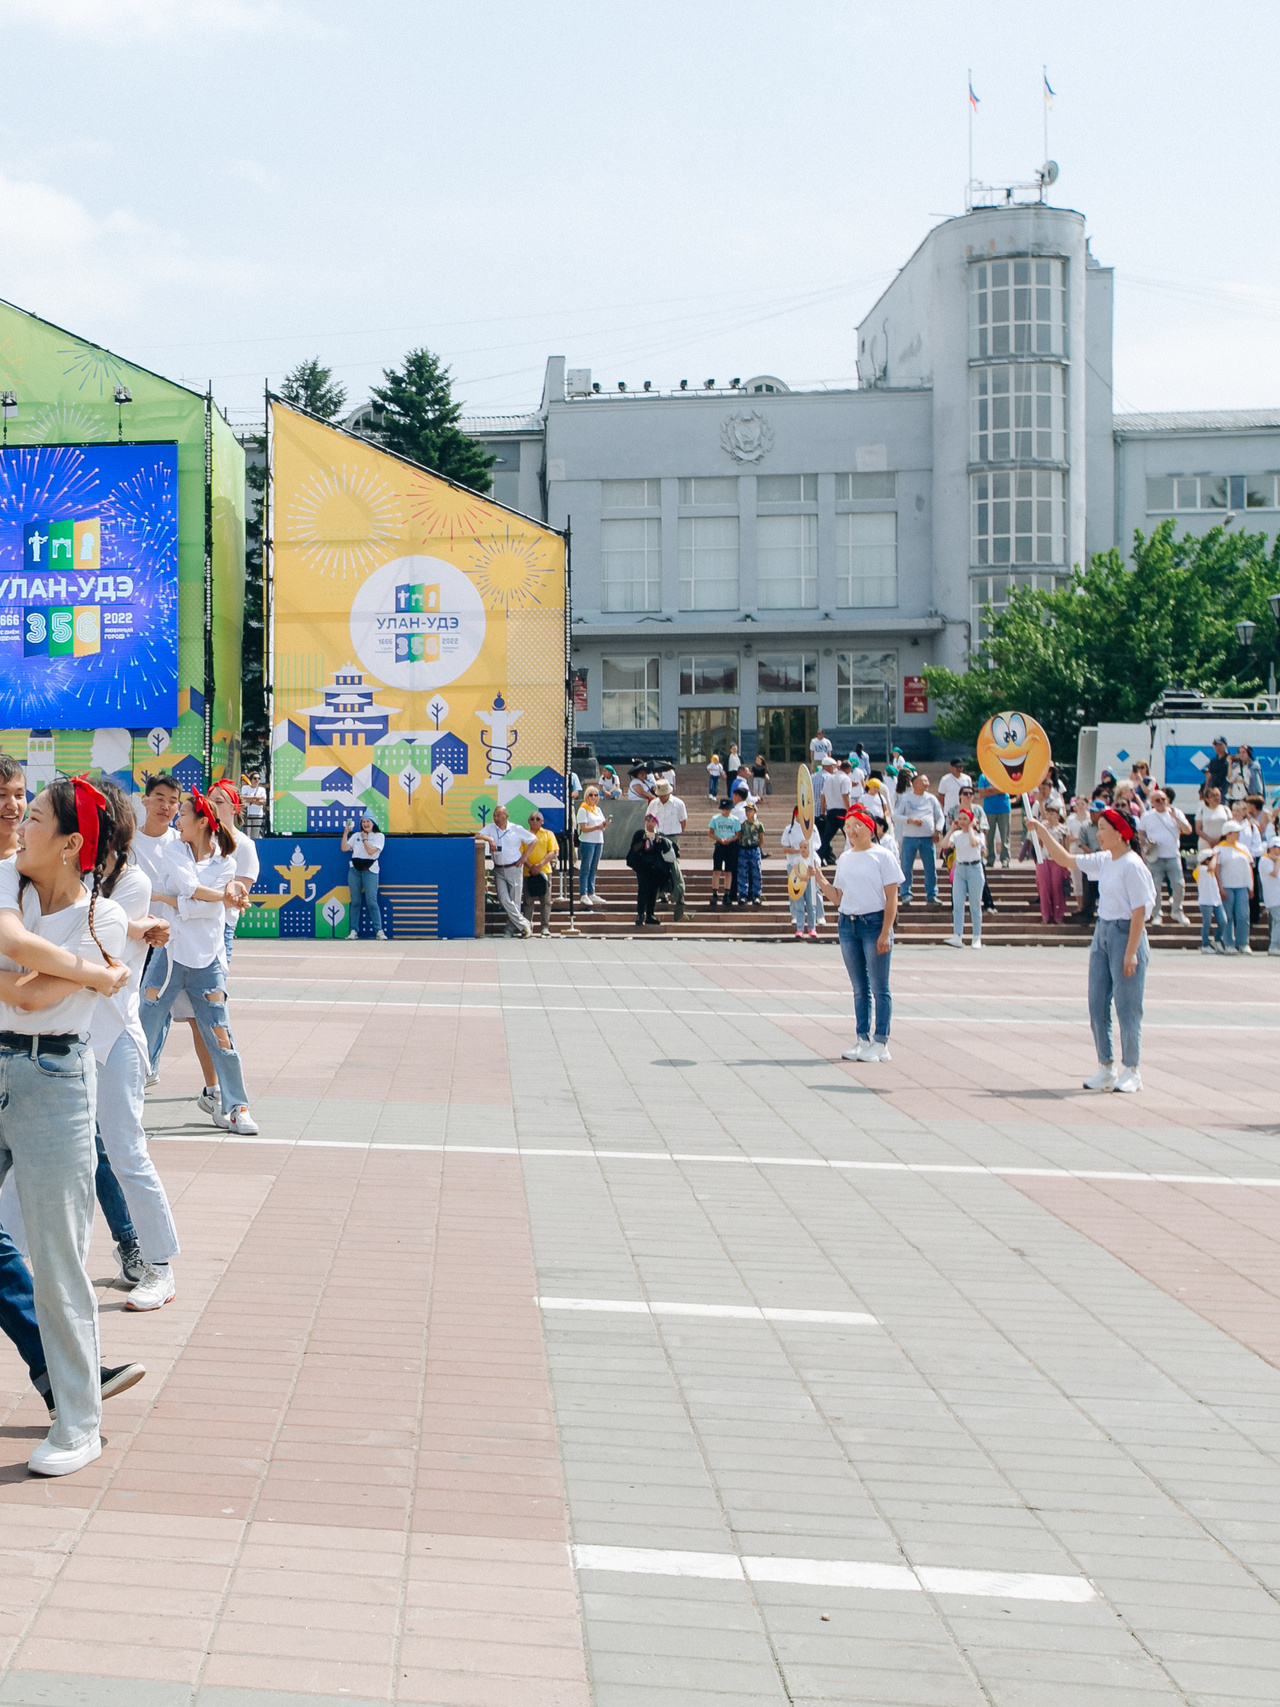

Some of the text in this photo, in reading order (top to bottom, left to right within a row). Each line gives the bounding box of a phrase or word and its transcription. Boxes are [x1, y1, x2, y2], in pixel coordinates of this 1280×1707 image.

[103, 612, 133, 624] 2022
[376, 617, 459, 631] УЛАН-УДЭ
[26, 612, 99, 644] 356
